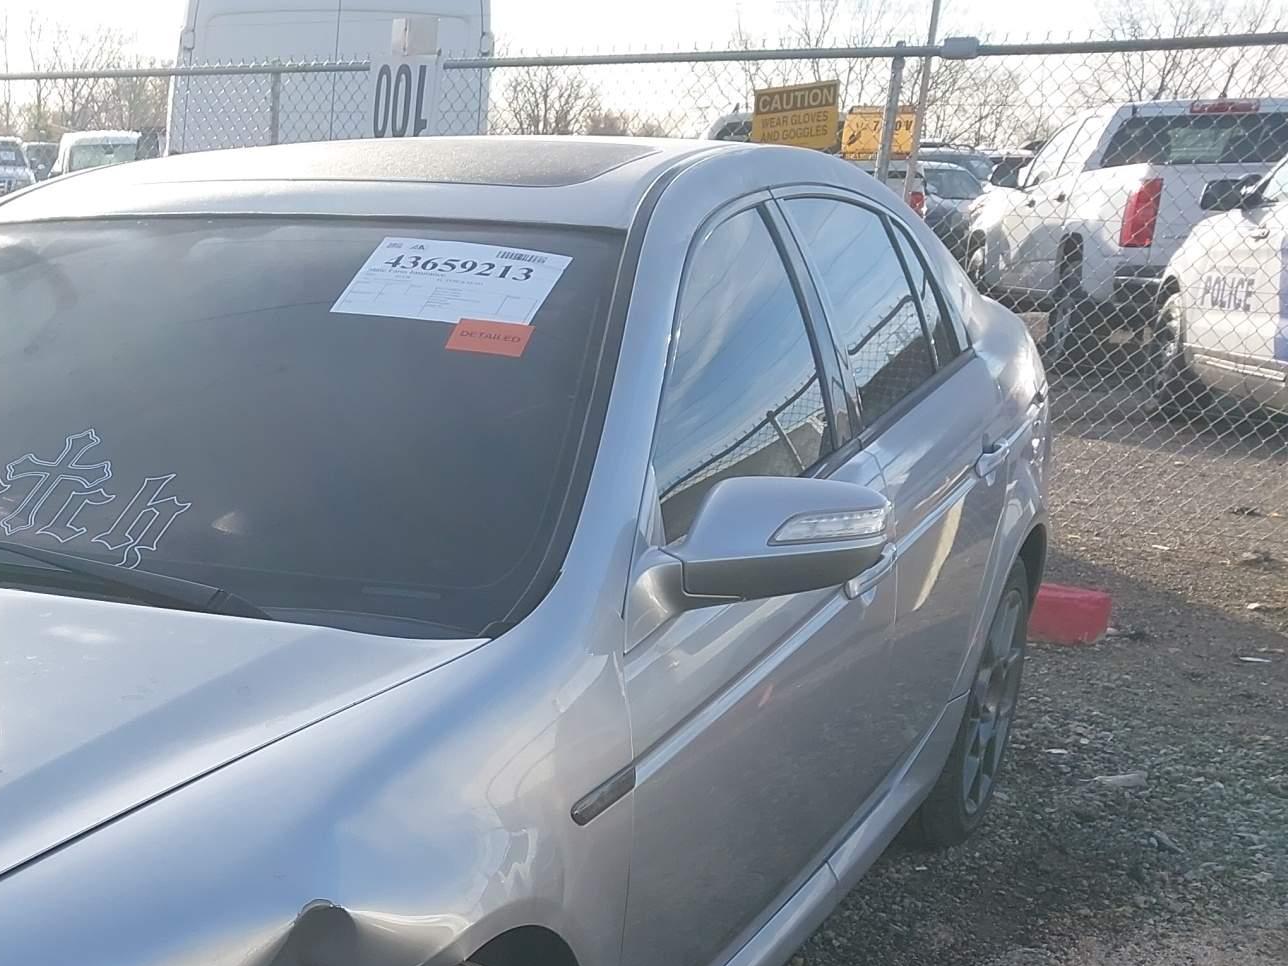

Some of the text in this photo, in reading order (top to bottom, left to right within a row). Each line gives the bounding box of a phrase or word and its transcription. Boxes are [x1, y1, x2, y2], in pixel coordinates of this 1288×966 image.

[373, 63, 428, 138] 100
[758, 86, 835, 112] CAUTION
[762, 111, 830, 129] WEAR GLOVES
[761, 125, 829, 143] AND GOGGLES
[384, 253, 535, 282] 43659213
[1200, 275, 1256, 312] POLICE
[459, 329, 522, 344] DETAILED
